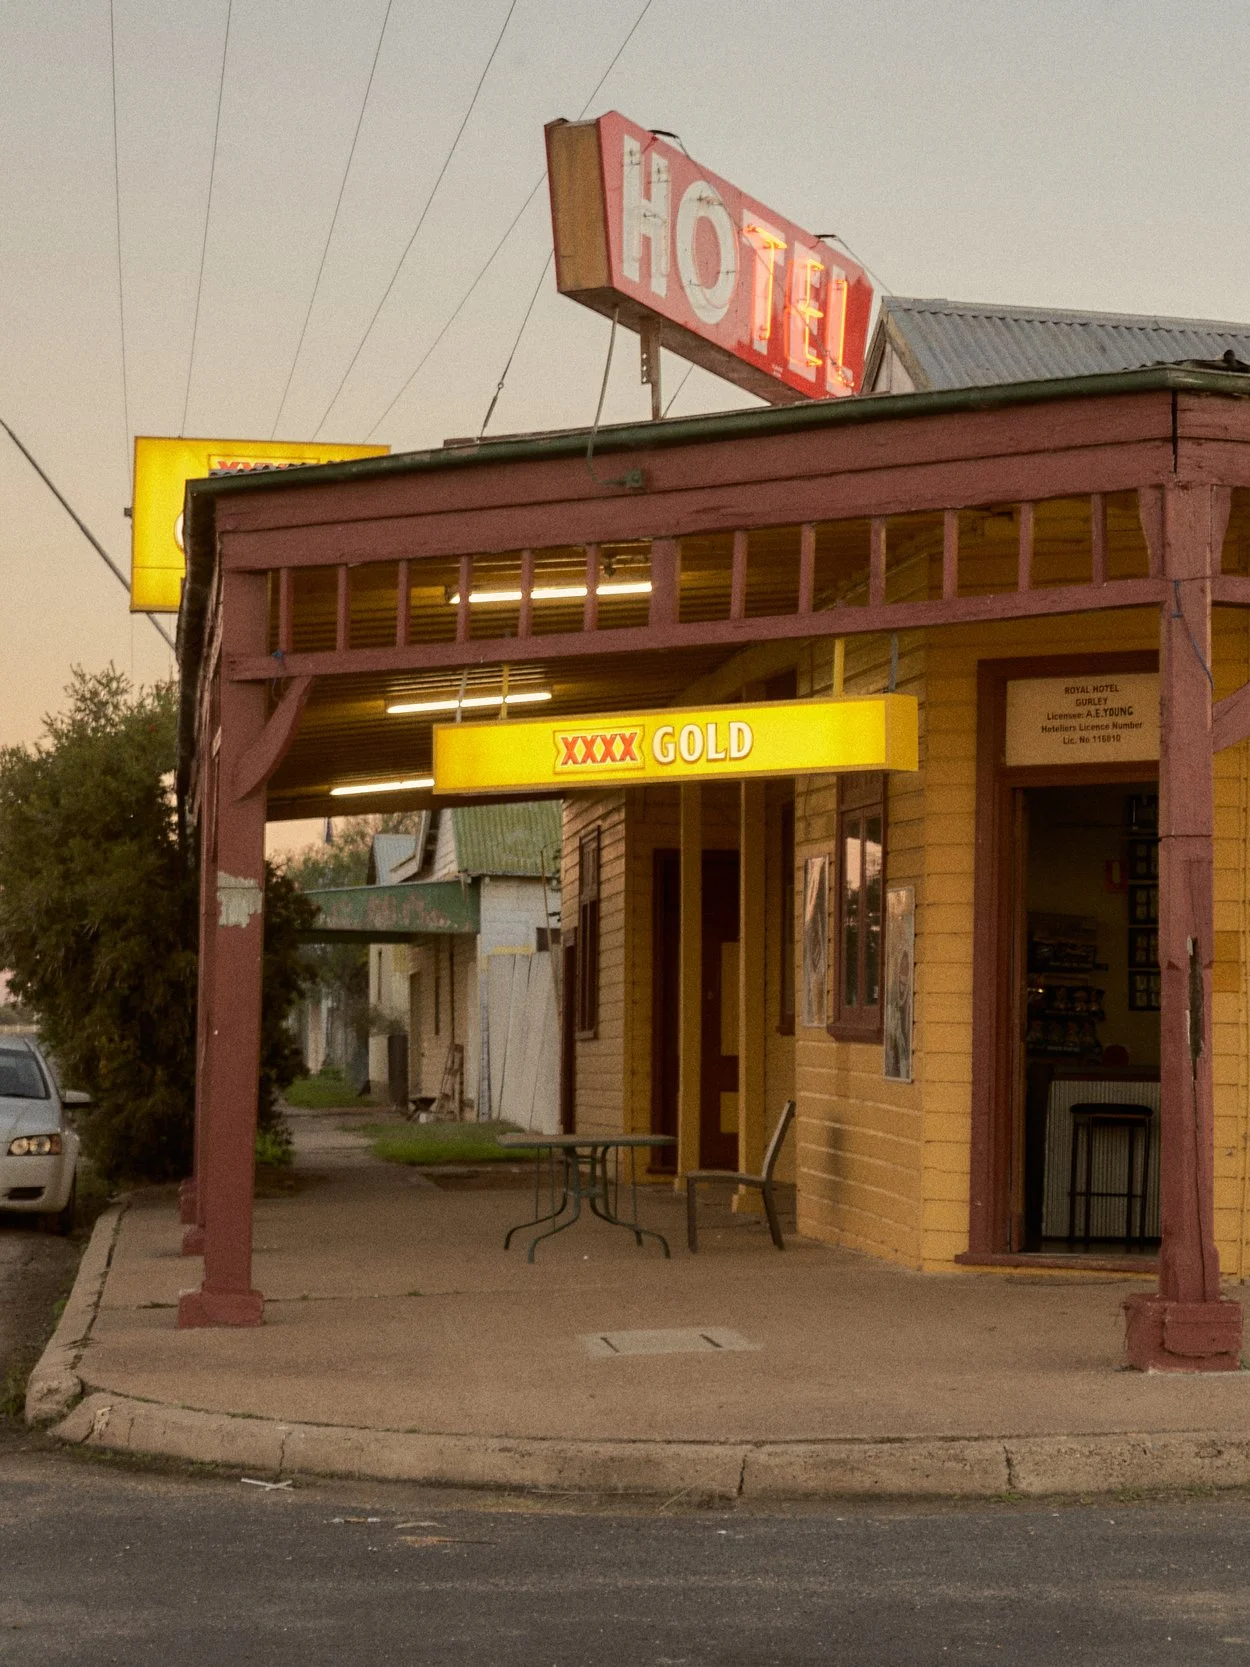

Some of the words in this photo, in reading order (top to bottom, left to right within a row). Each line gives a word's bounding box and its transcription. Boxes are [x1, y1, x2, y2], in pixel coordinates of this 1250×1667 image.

[622, 134, 855, 397] HOTEL
[1064, 685, 1090, 694] ROYAL
[1092, 683, 1119, 693] HOTEL
[1075, 697, 1108, 706] GURLEY
[1047, 712, 1084, 720] Licensee:
[1041, 724, 1077, 733] Hoteliers
[1079, 722, 1109, 731] Licence
[1112, 720, 1143, 730] Number
[560, 731, 638, 766] XXXX
[652, 721, 754, 764] GOLD
